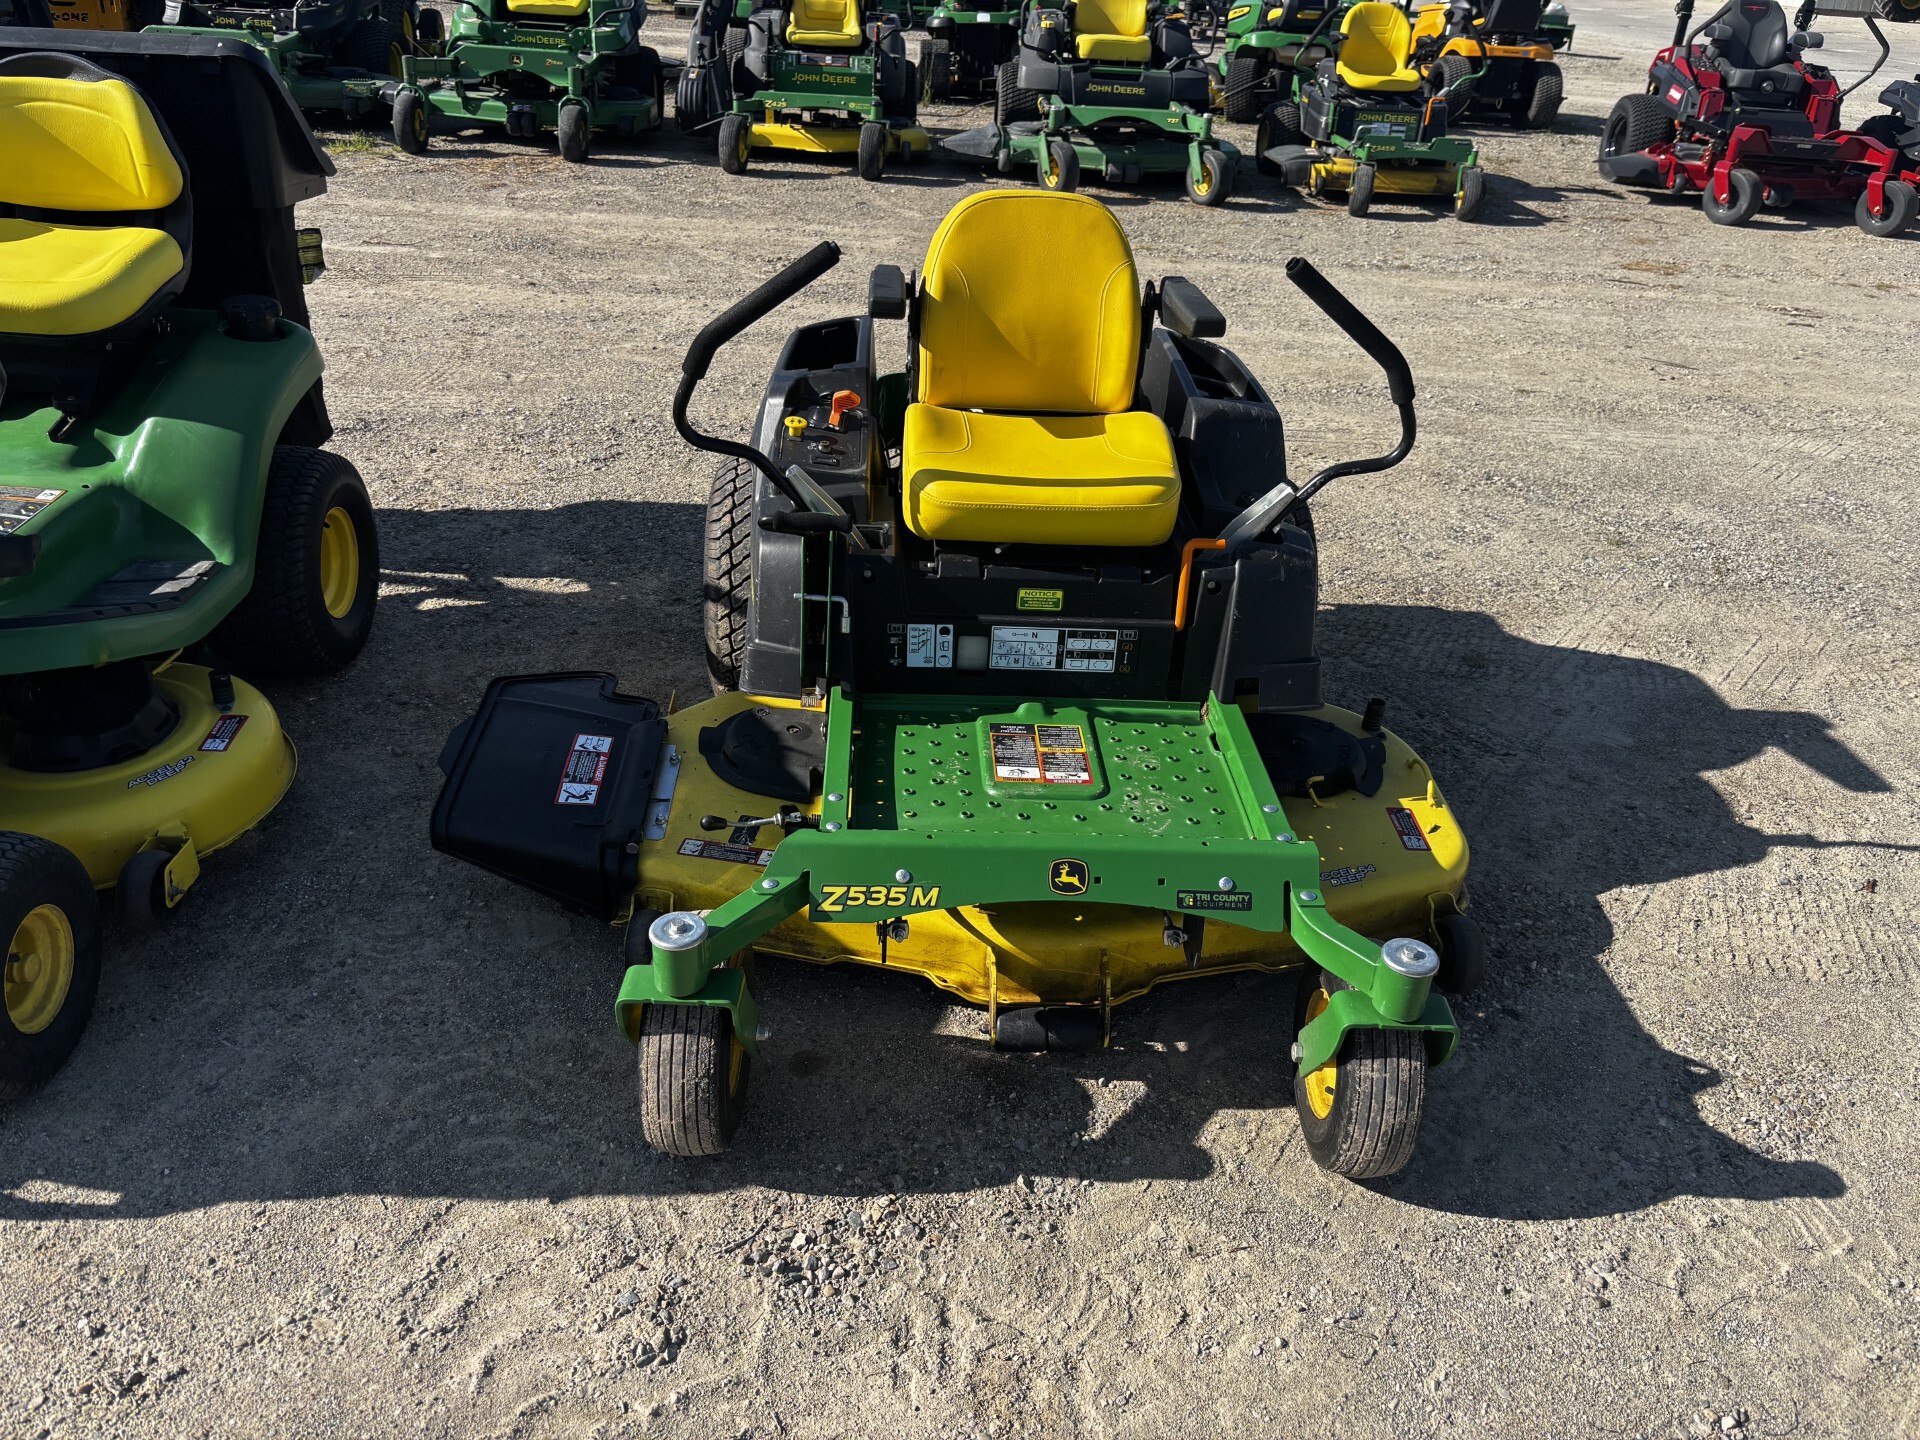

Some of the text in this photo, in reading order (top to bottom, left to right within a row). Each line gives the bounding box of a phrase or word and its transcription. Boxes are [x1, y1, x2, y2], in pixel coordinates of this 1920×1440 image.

[511, 34, 567, 45] JOHN DEERE
[792, 72, 857, 84] JOHN DEERE
[1086, 83, 1146, 95] JOHN DEERE
[765, 99, 787, 108] Z425
[1355, 112, 1417, 123] JOHN DEERE
[128, 764, 177, 789] ACCEL
[146, 765, 185, 786] DEEP
[1320, 864, 1376, 880] CCEL 54
[1330, 874, 1366, 887] DEEP
[1195, 893, 1211, 901] TRI
[1213, 894, 1250, 902] COUNTY
